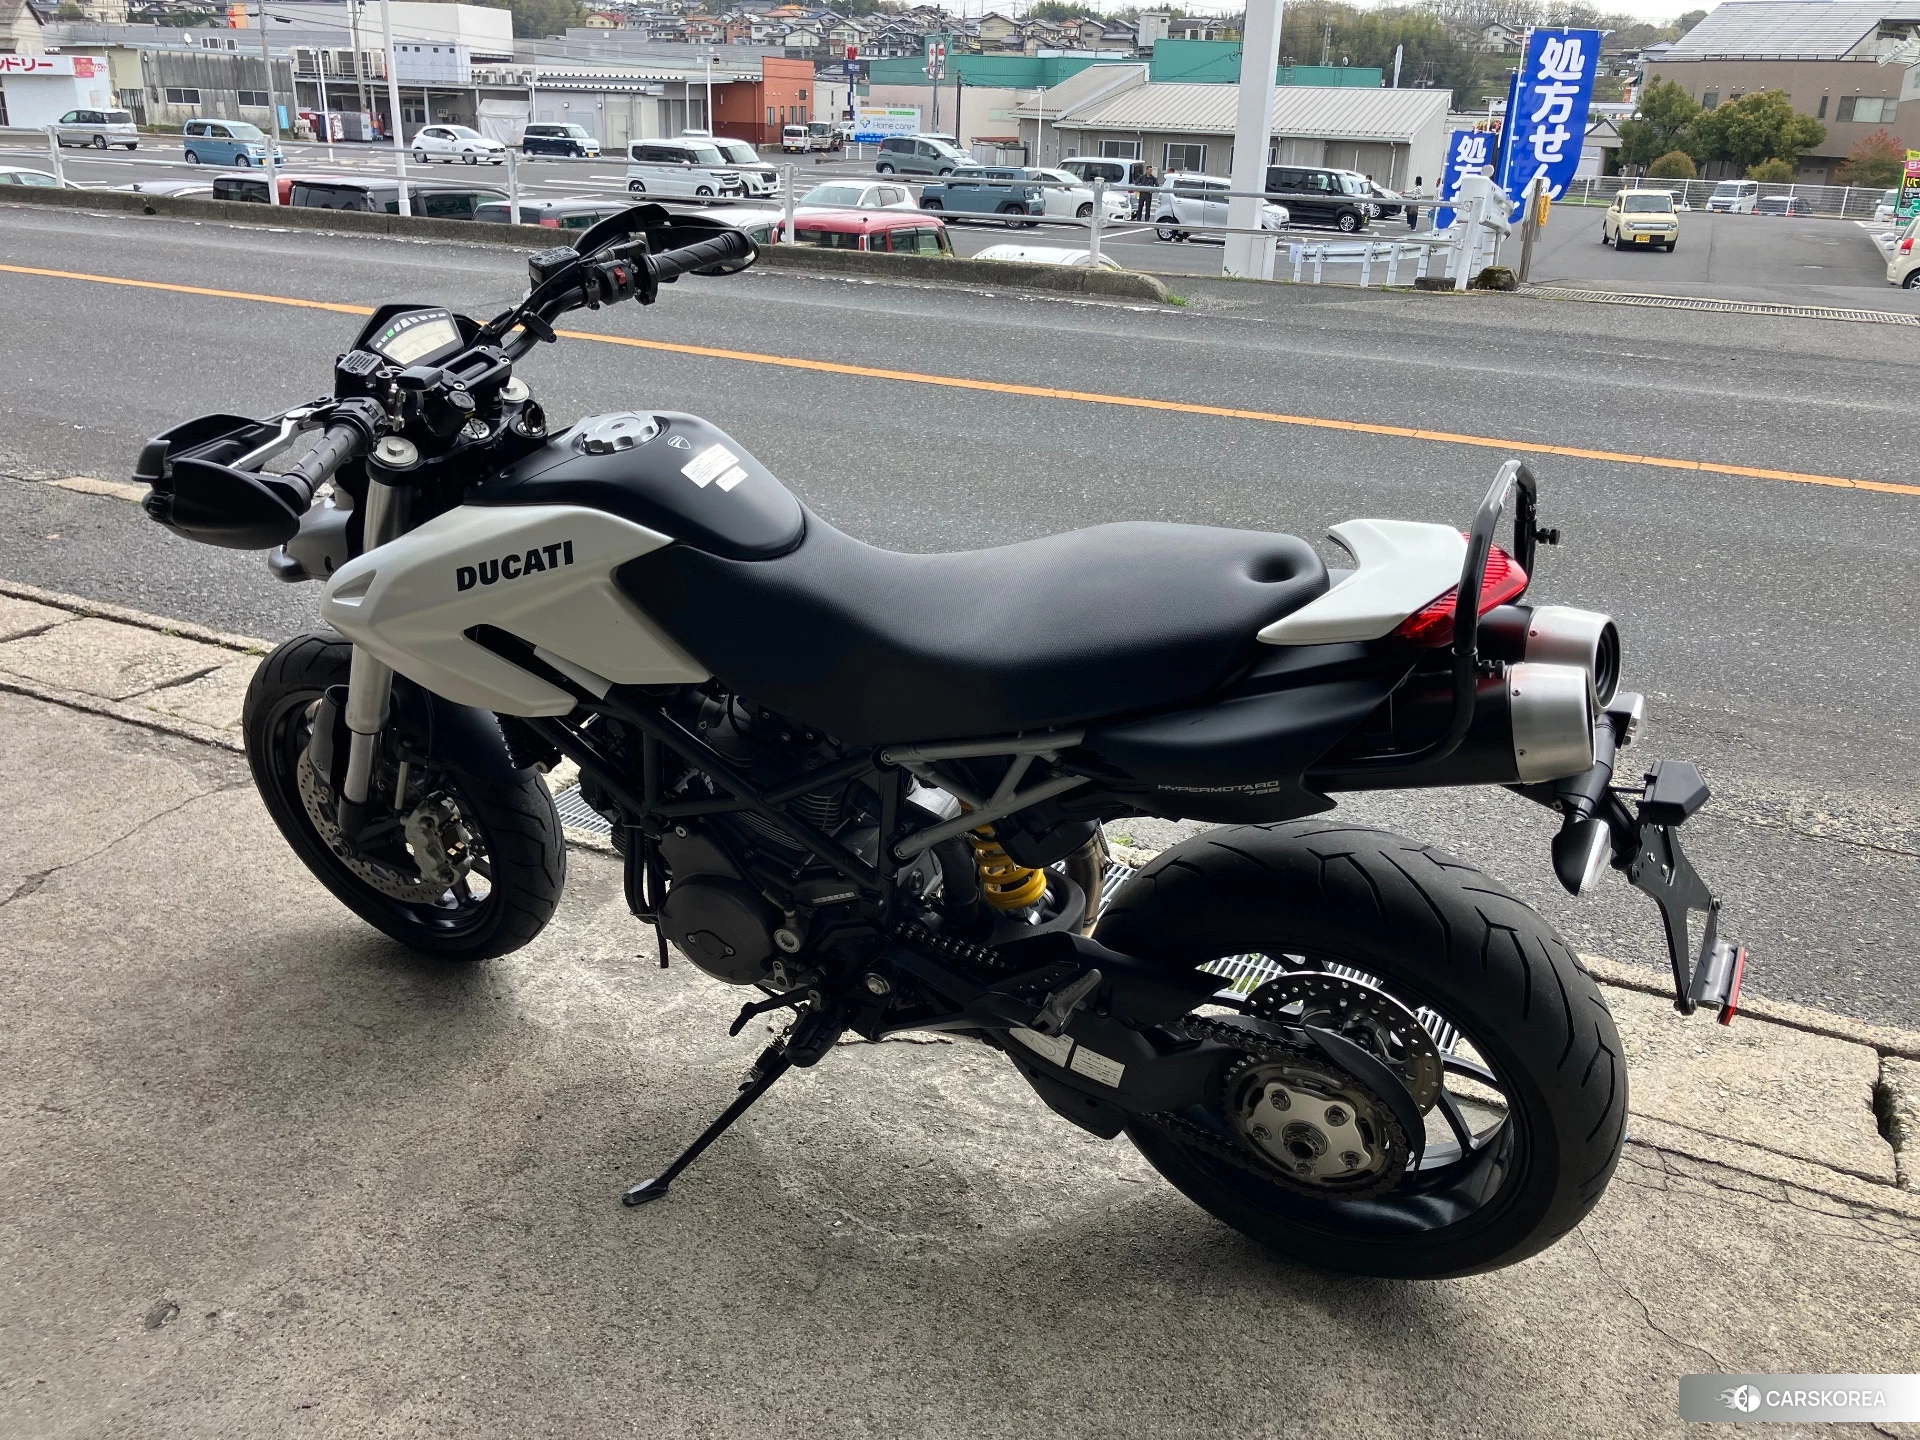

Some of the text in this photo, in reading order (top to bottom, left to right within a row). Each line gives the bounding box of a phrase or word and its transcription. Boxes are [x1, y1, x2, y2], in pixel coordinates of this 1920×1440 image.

[873, 121, 894, 130] Home
[1521, 37, 1585, 200] 処方せん
[456, 540, 574, 592] DUCATI
[1157, 780, 1280, 793] HYPERMOTARD
